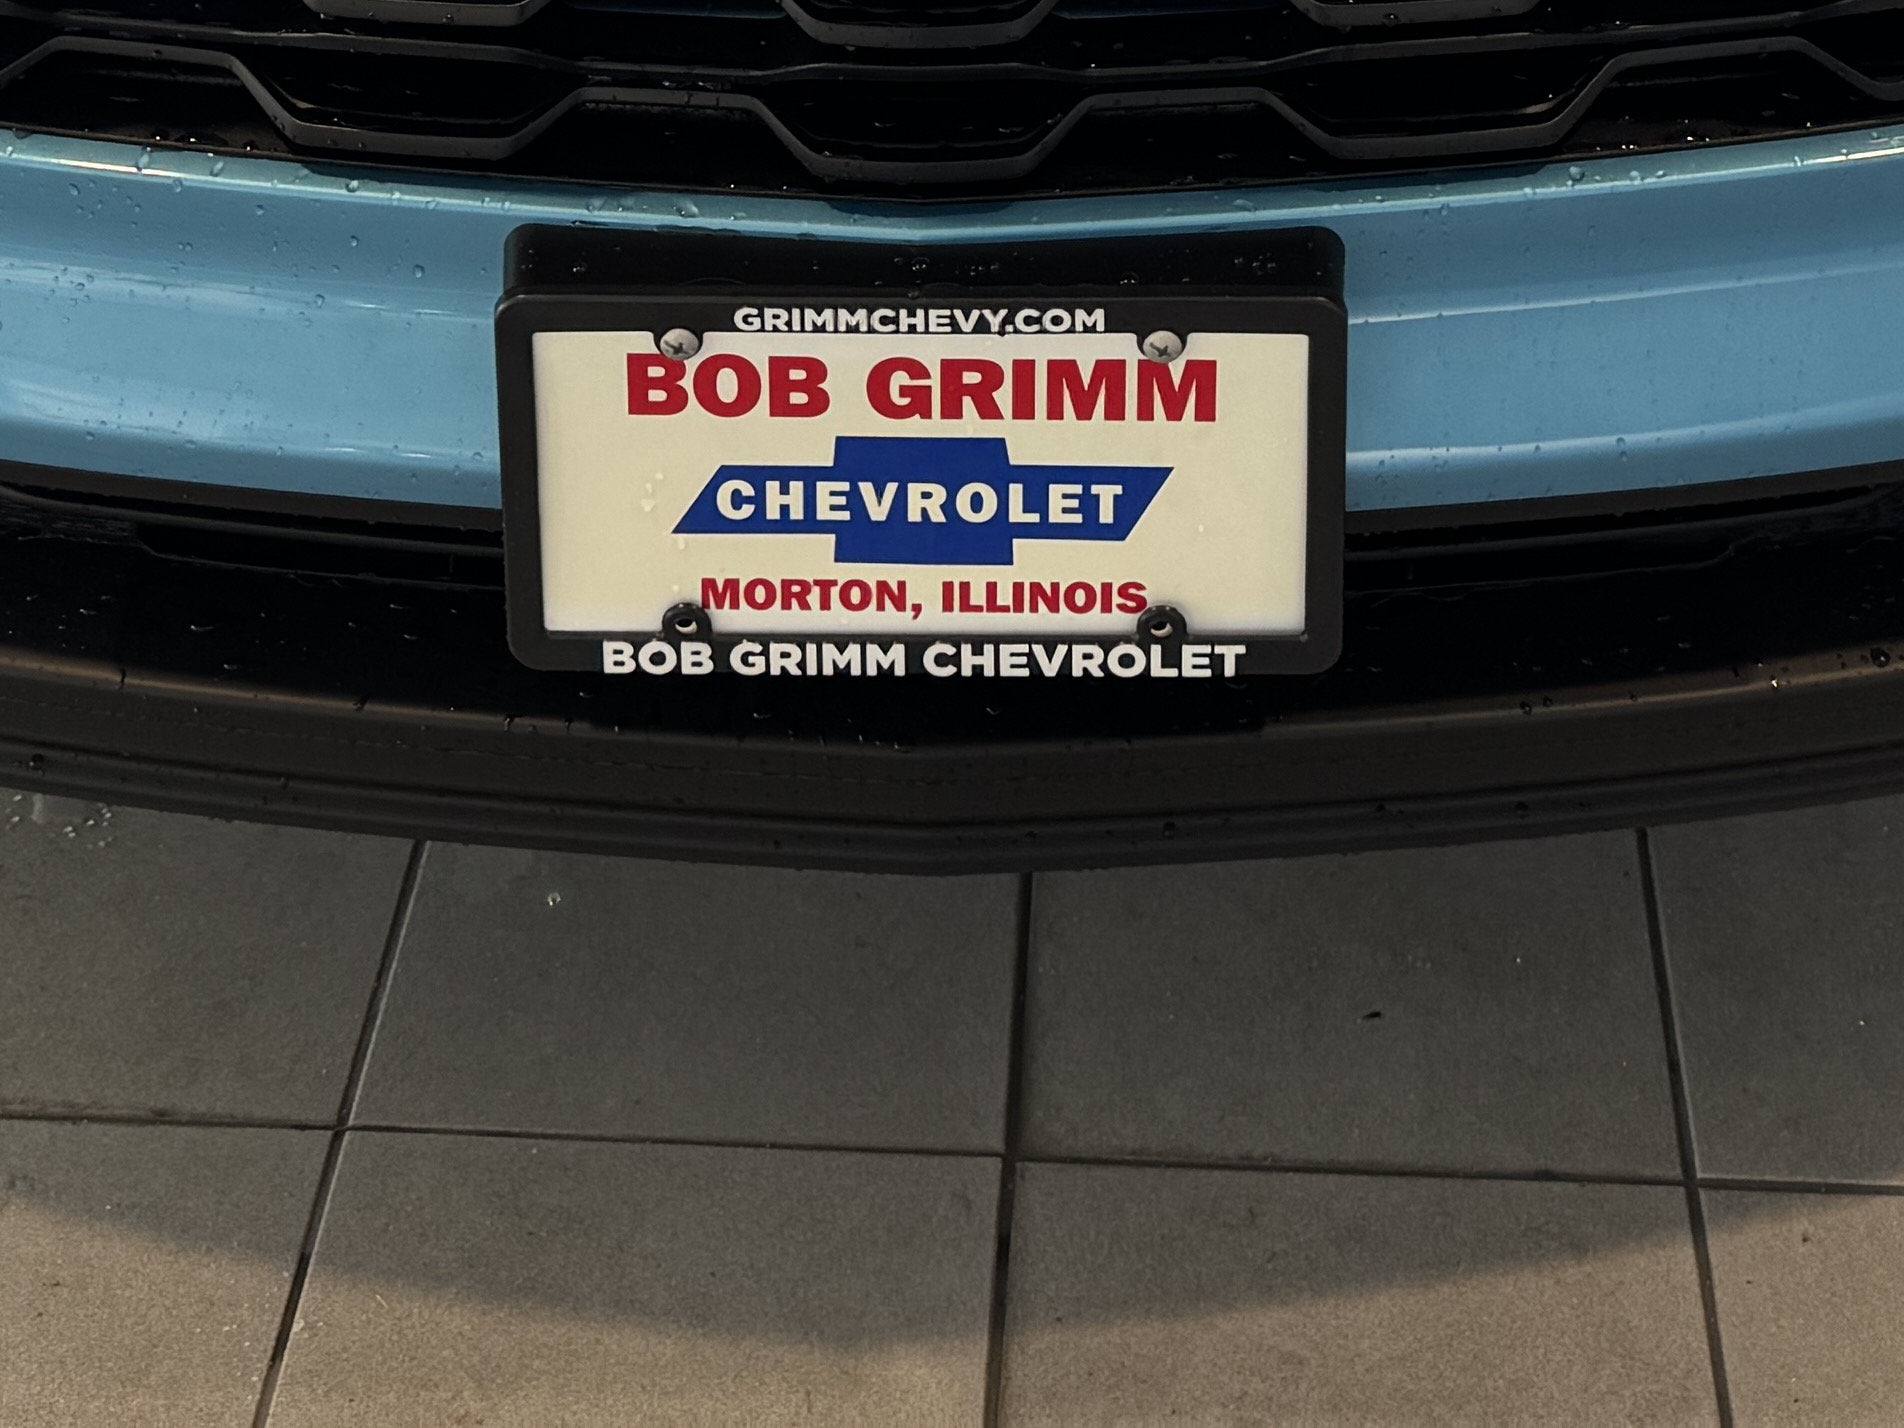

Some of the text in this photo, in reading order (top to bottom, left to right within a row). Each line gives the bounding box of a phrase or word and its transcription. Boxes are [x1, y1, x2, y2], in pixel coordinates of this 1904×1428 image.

[733, 308, 1106, 334] GRIMMCHEVY.COM
[626, 352, 1217, 422] BOB GRIMM
[715, 479, 1124, 525] CHEVROLET
[700, 577, 1149, 620] MORTON, ILLINOIS
[603, 639, 1247, 679] BOB GRIMM CHEVROLET
